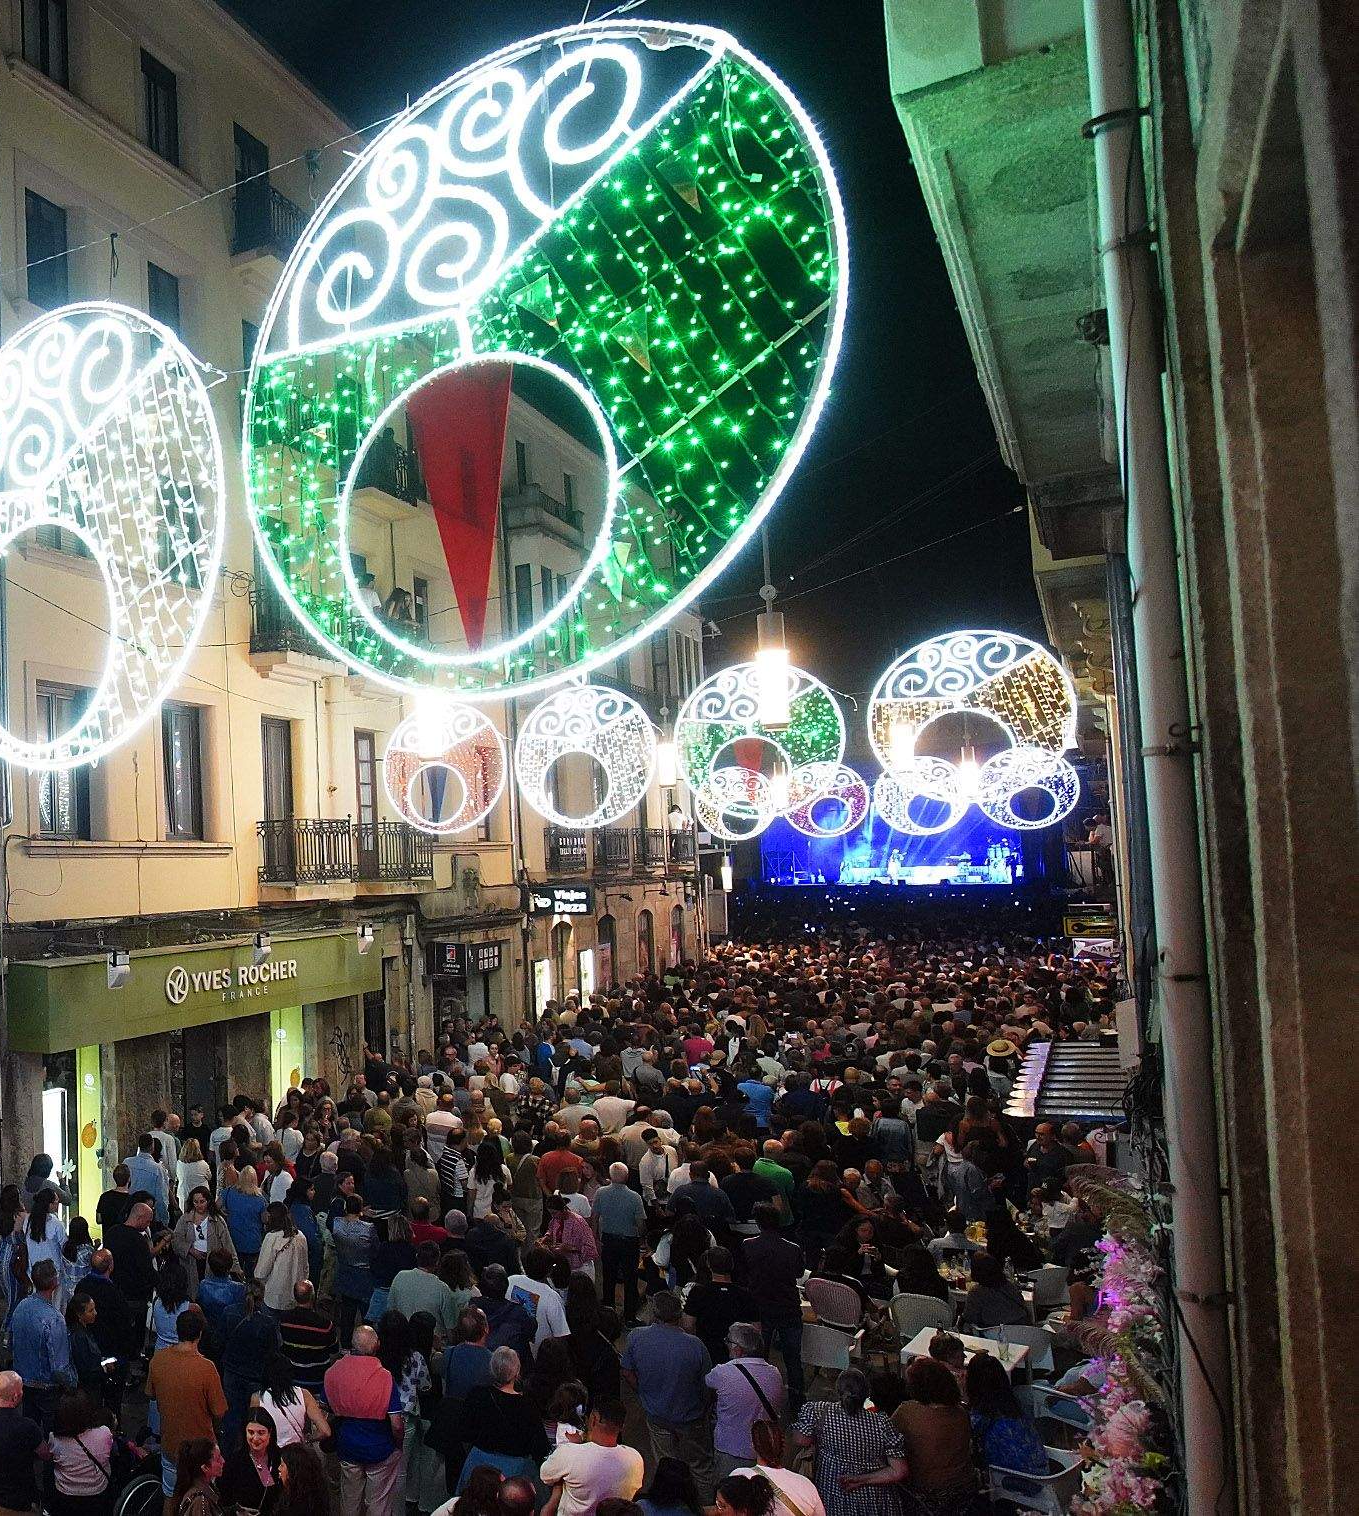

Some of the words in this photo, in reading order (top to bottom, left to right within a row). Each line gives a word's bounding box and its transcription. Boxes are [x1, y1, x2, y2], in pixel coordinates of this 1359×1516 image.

[554, 889, 587, 901] Viajes
[554, 901, 588, 912] Deza
[191, 967, 232, 993] YVES
[237, 960, 298, 986] ROCHER
[222, 986, 269, 1001] FRANCE
